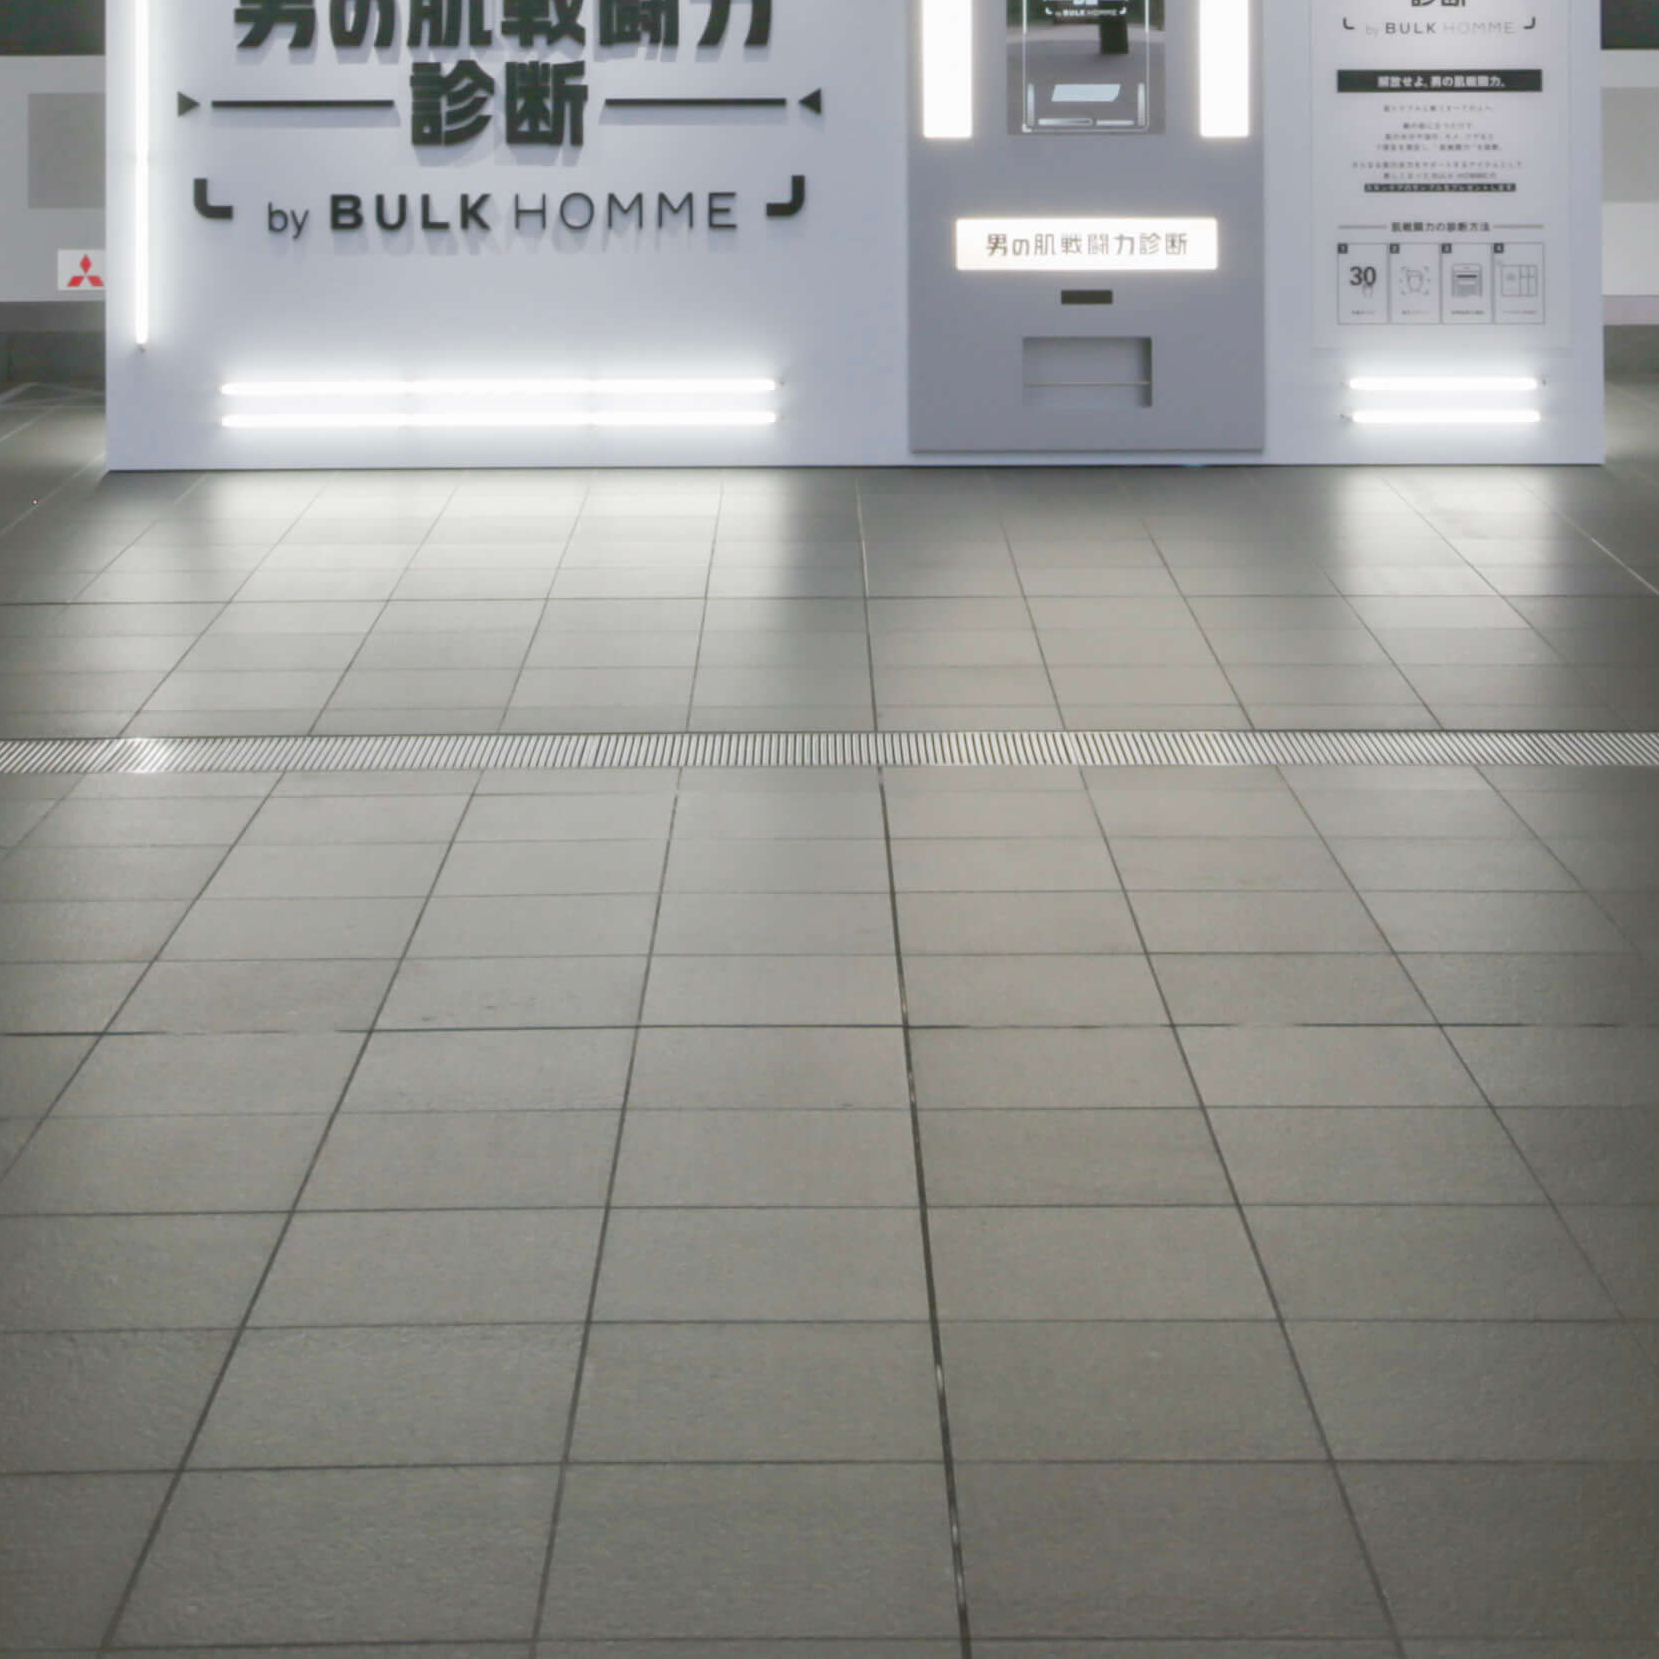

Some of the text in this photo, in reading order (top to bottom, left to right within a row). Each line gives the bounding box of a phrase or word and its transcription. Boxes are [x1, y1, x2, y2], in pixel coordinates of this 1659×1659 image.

[1384, 21, 1437, 35] BULK
[1443, 21, 1516, 35] HOMME
[409, 59, 588, 146] 診断
[267, 191, 738, 240] by BULK HOMME
[986, 232, 1188, 257] 男の肌戦闘力診断
[1349, 265, 1377, 287] 30
